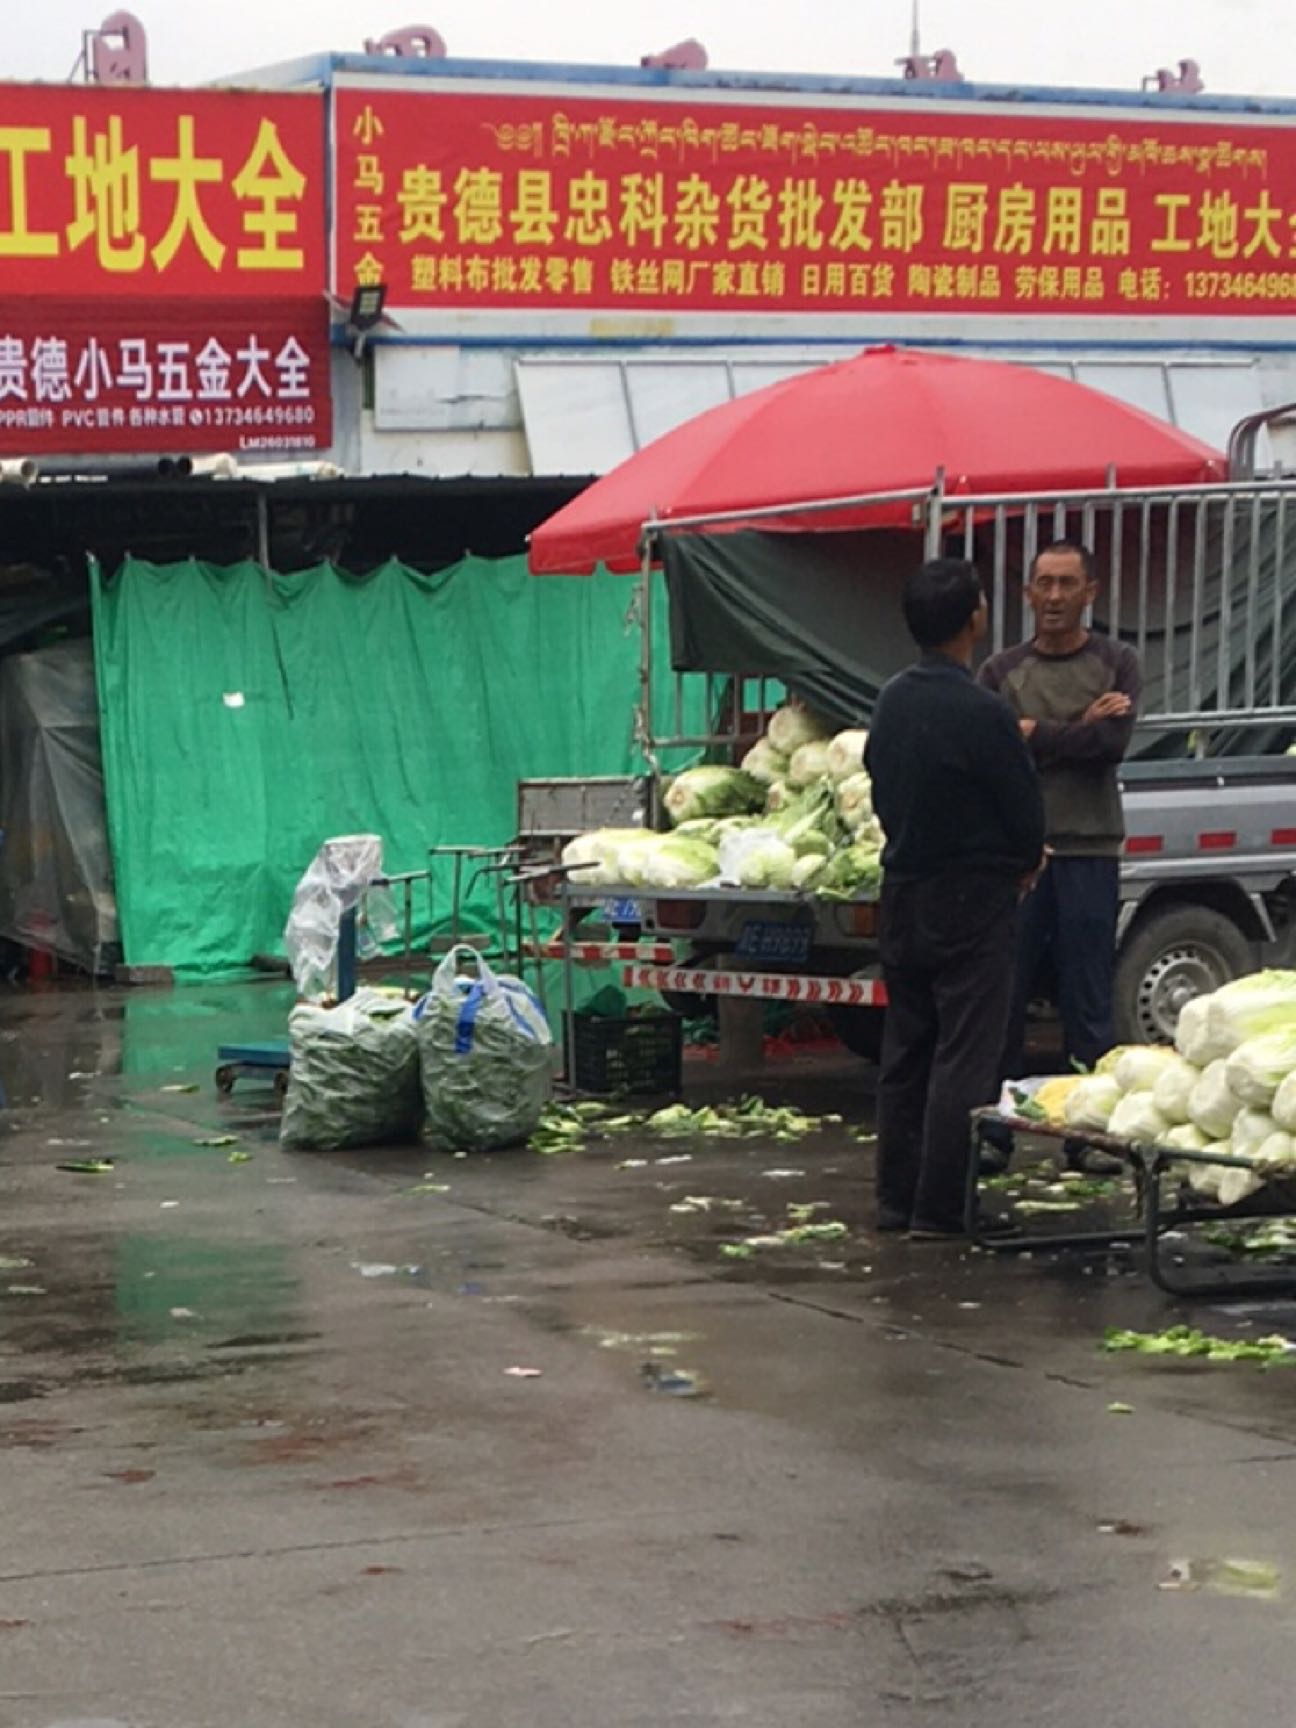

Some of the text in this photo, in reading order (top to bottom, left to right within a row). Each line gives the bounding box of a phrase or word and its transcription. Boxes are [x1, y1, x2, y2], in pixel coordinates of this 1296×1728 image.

[397, 164, 1296, 259] 贵德县忠科杂货批发部 厨房用品 工地大
[411, 254, 593, 294] 塑料布批发零售
[611, 258, 785, 296] 铁丝网厂家直销
[801, 262, 894, 297] 日用百货
[908, 263, 1000, 298] 陶瓷制品
[1015, 265, 1104, 299] 劳保用品
